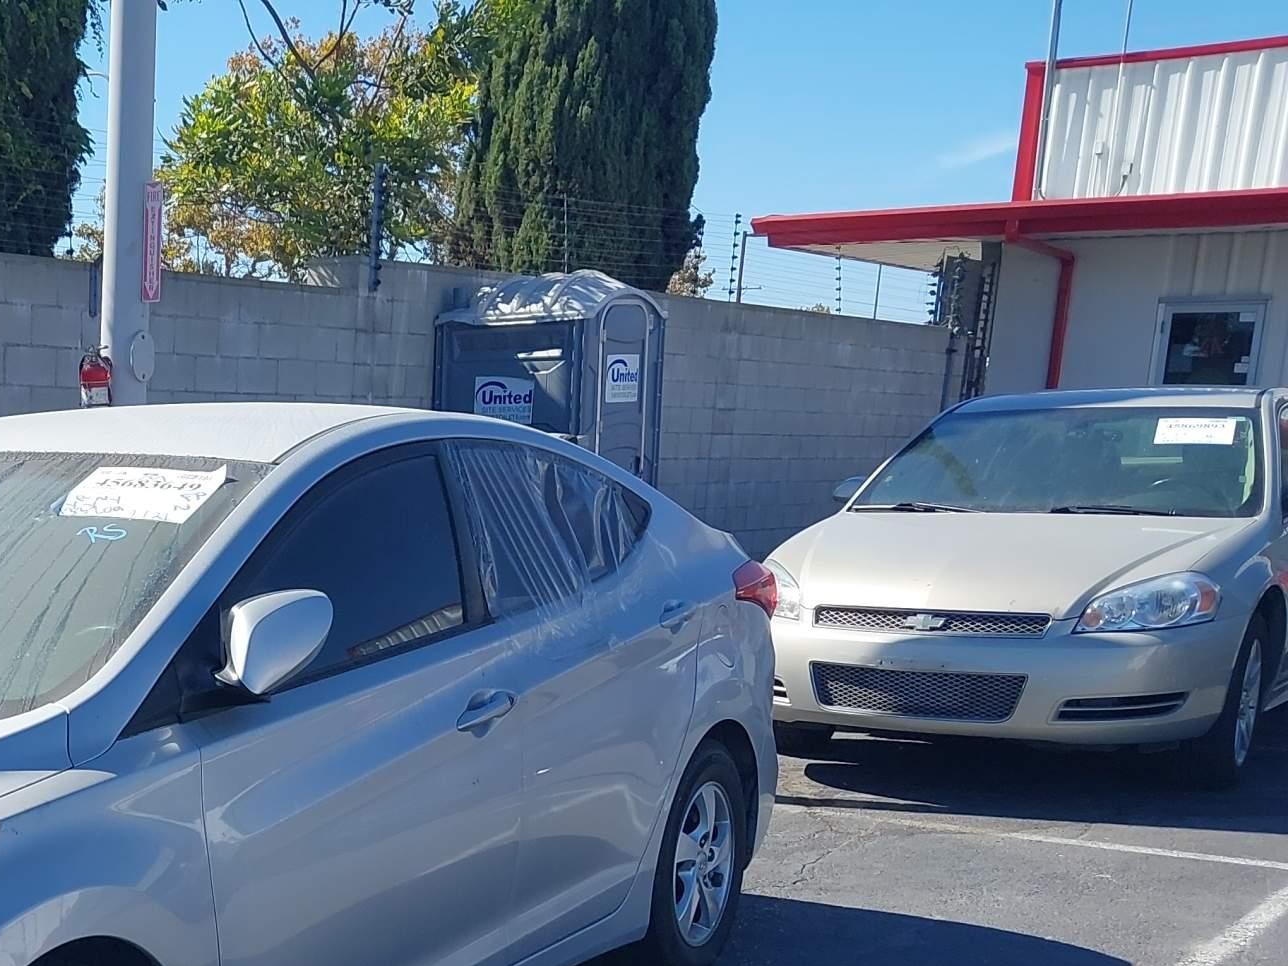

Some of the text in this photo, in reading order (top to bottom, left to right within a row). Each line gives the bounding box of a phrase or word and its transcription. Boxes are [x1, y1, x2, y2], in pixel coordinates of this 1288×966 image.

[147, 191, 160, 202] FIRE
[481, 389, 533, 405] United
[96, 477, 203, 492] 45683649
